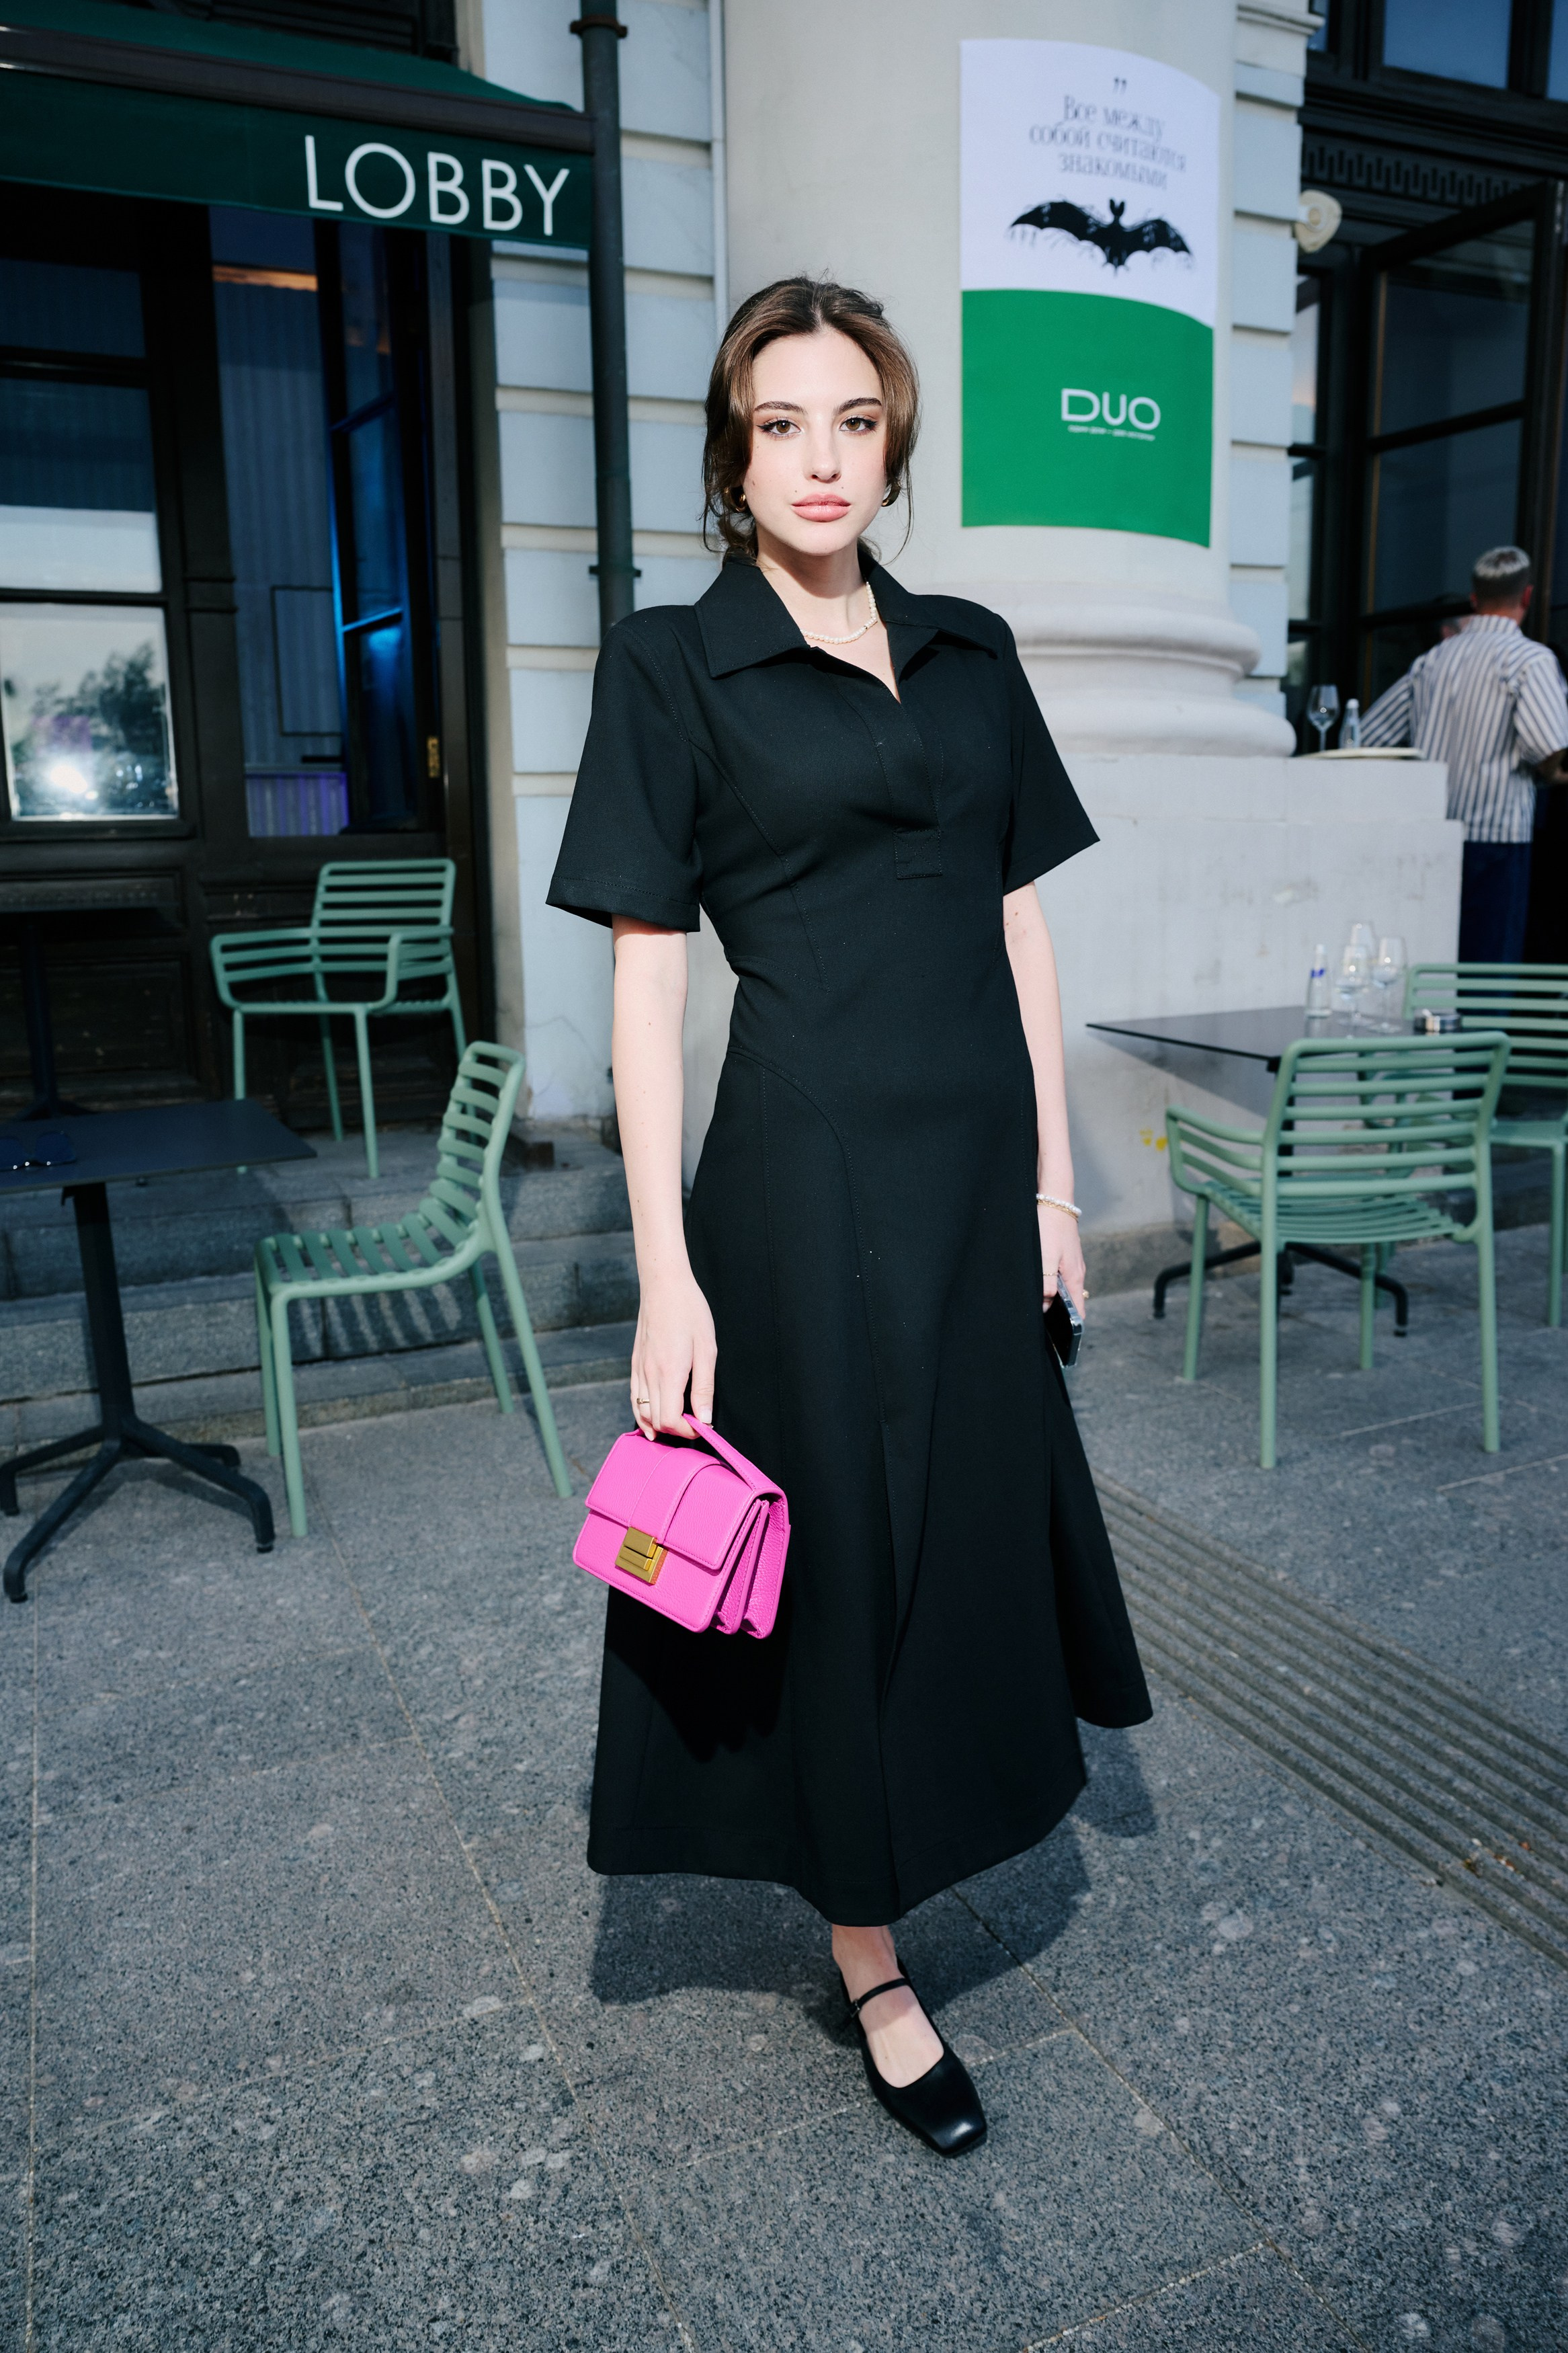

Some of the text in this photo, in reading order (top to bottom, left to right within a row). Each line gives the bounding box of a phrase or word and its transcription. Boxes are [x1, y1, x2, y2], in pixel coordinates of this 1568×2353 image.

[1063, 94, 1165, 143] Все между
[1028, 120, 1187, 173] собой считаются
[1058, 151, 1168, 191] знакомыми
[304, 134, 570, 237] LOBBY
[1061, 388, 1161, 431] DUO
